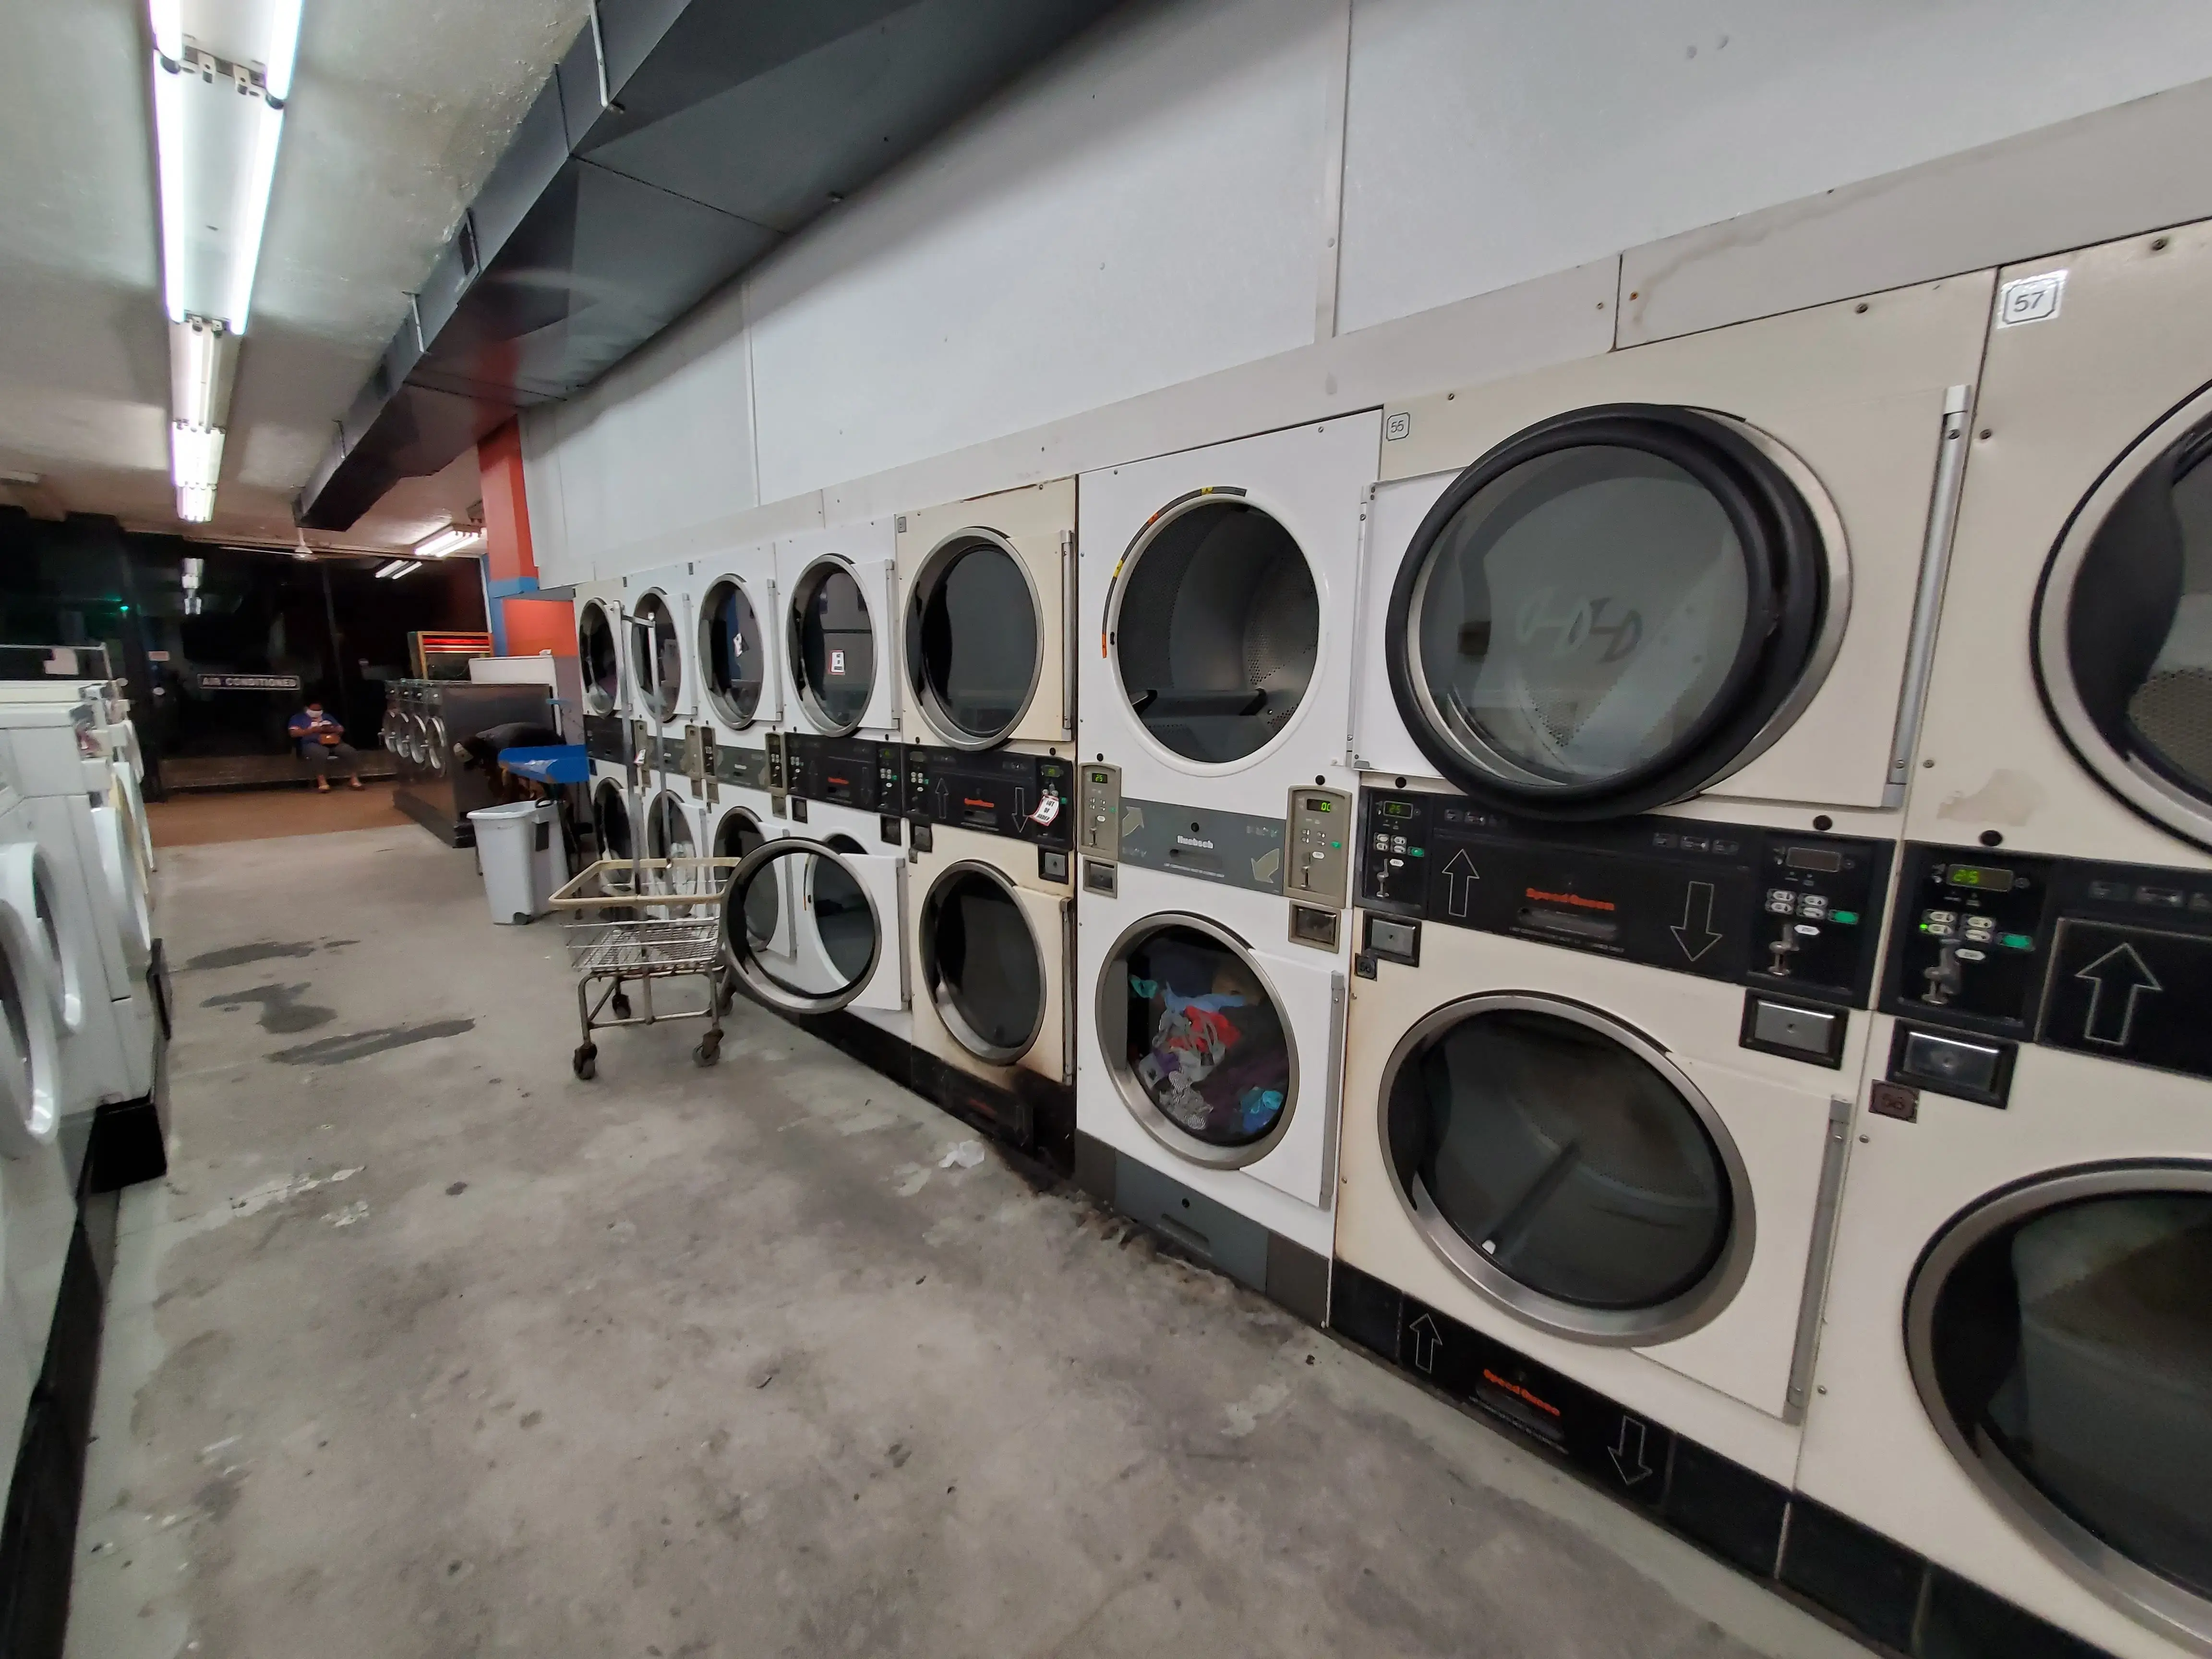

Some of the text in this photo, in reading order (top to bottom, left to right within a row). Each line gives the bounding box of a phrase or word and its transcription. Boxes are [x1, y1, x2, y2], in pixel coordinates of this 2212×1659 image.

[2013, 289, 2046, 313] 57
[1390, 420, 1405, 433] 55
[203, 677, 297, 687] AIR CONDITIONED
[1953, 868, 1979, 885] 25
